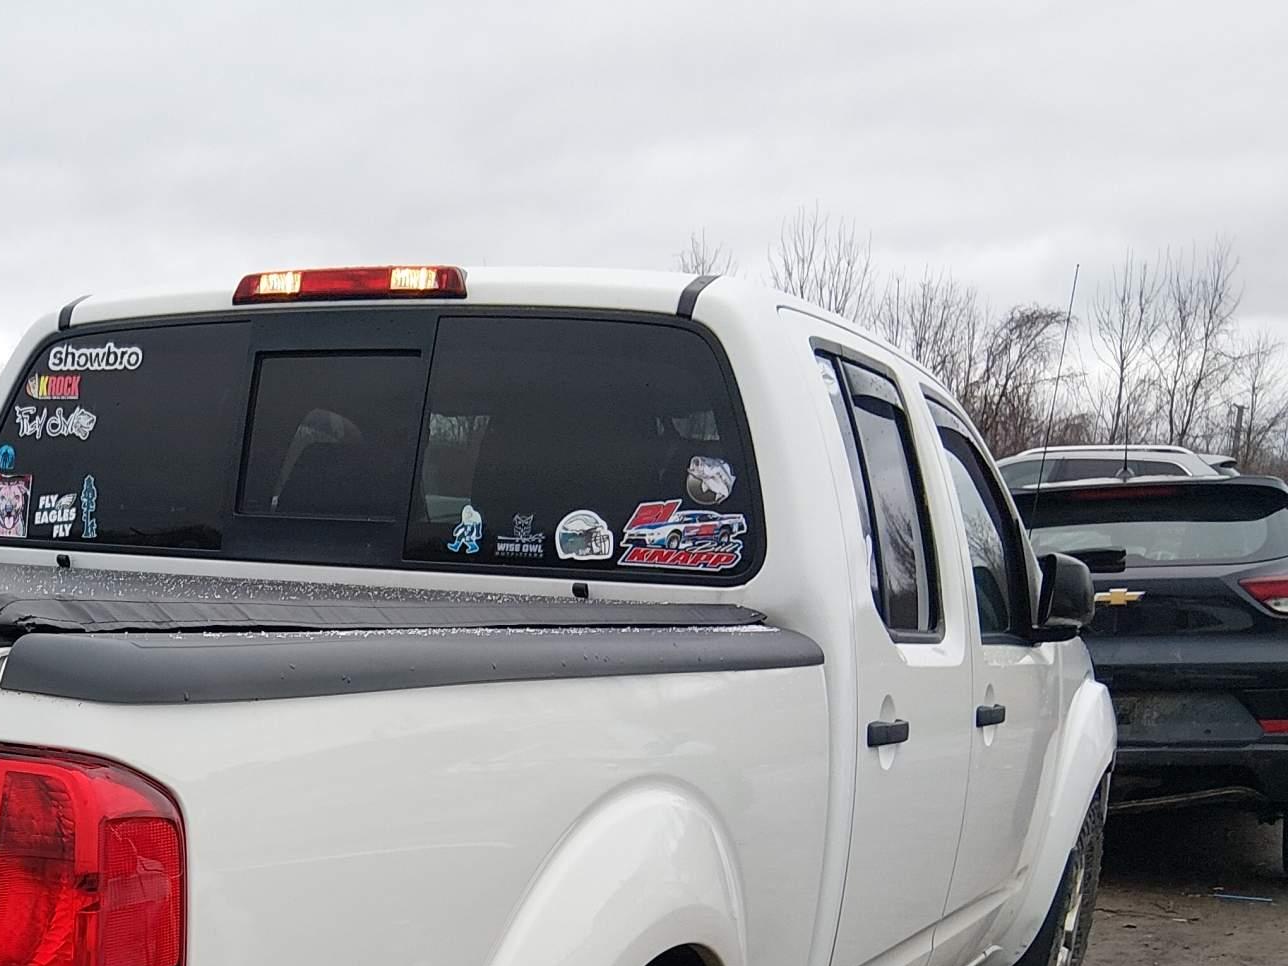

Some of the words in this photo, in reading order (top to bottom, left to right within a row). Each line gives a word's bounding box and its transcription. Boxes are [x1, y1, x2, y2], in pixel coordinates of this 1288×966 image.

[50, 343, 141, 369] showbro
[39, 494, 59, 509] FLY
[34, 507, 76, 524] EAGLES
[627, 501, 679, 529] 21
[53, 524, 72, 538] FLY
[496, 543, 521, 552] WISE
[522, 544, 544, 553] OWL
[625, 547, 737, 567] KNAPP
